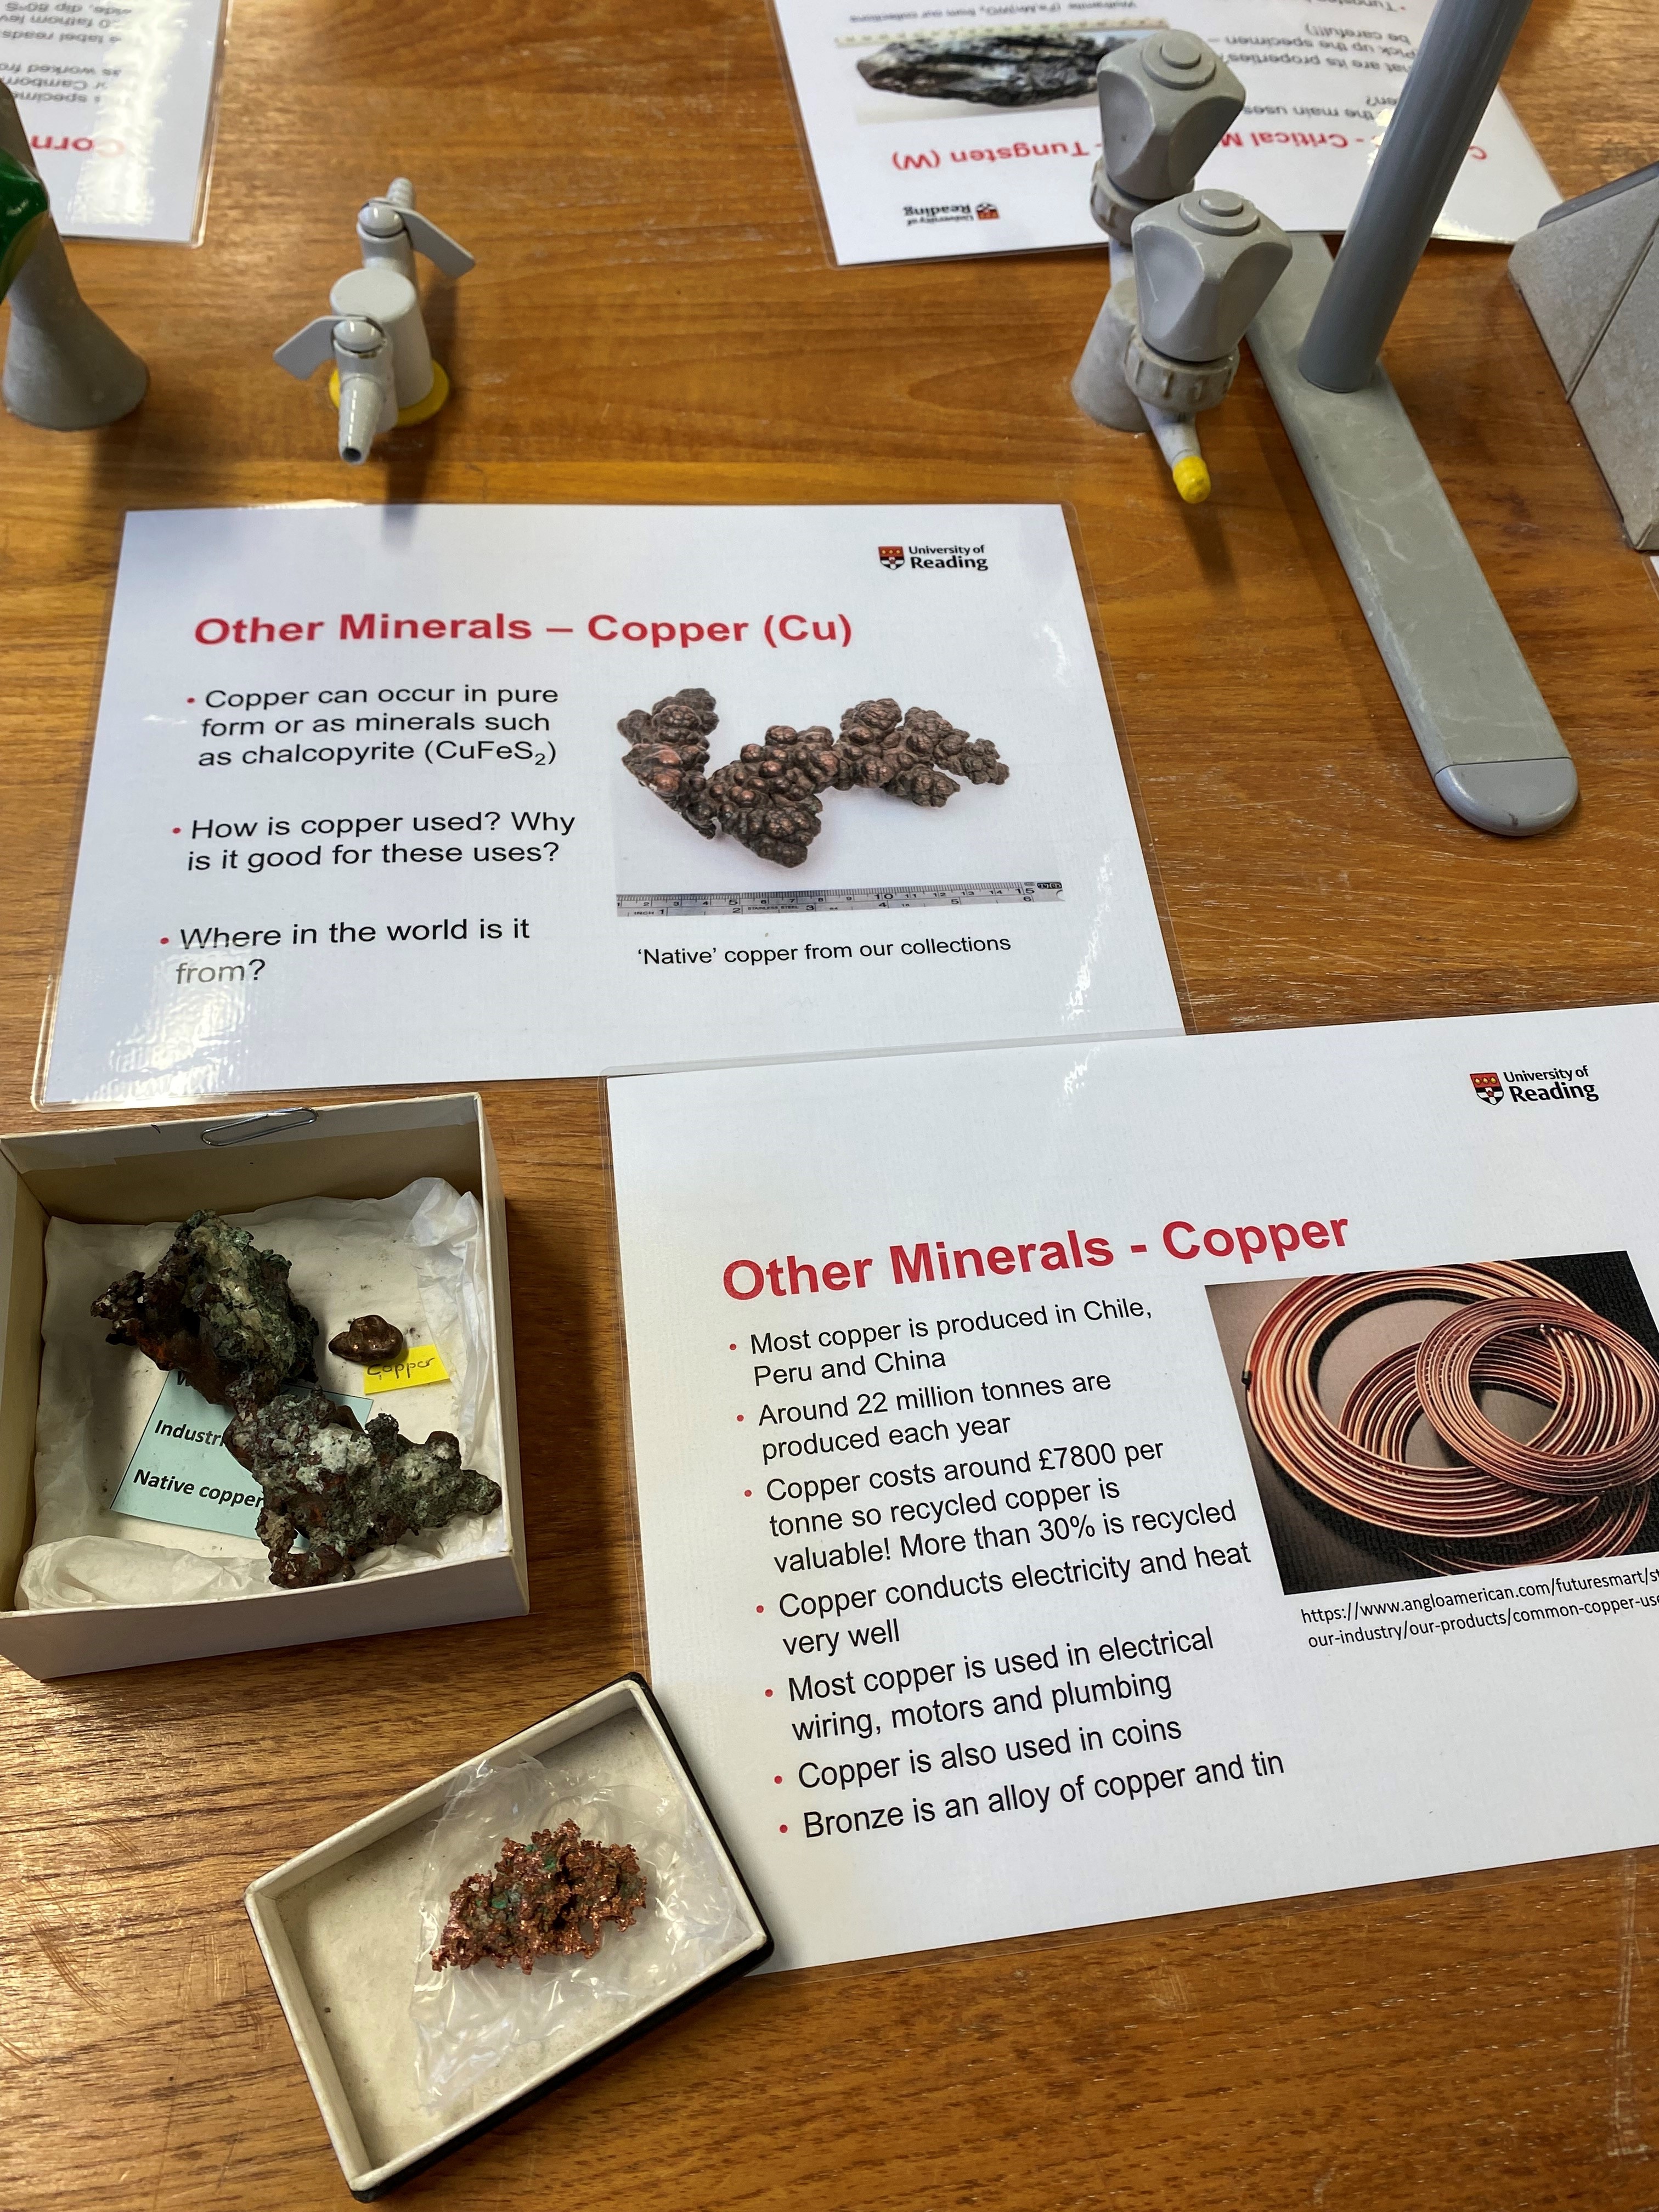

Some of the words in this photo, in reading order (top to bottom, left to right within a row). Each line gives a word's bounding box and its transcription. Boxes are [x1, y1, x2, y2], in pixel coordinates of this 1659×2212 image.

[59, 34, 104, 44] label
[1224, 35, 1314, 49] specimen
[1319, 40, 1347, 52] the
[26, 64, 95, 75] worked
[1352, 59, 1380, 70] are
[1293, 105, 1339, 119] main
[950, 142, 1089, 163] Tungsten
[1250, 131, 1349, 149] Critical
[891, 149, 942, 172] (W)
[902, 204, 972, 217] Reading
[909, 545, 970, 556] University
[973, 545, 985, 554] of
[911, 555, 989, 571] Reading
[194, 616, 325, 645] Other
[339, 612, 532, 640] Minerals
[588, 614, 749, 648] Copper
[763, 613, 852, 648] (Cu)
[205, 690, 310, 712] Copper
[318, 689, 368, 704] can
[377, 688, 456, 703] occur
[465, 684, 487, 702] in
[498, 689, 558, 707] pure
[201, 718, 264, 737] form
[274, 719, 304, 734] or
[312, 718, 346, 733] as
[356, 712, 476, 732] minerals
[484, 713, 550, 731] such
[198, 751, 232, 767] as
[241, 741, 415, 766] chalcopyrite
[191, 819, 258, 839] How
[268, 816, 290, 836] is
[301, 817, 404, 839] copper
[413, 811, 501, 832] used?
[510, 811, 575, 836] Why
[188, 851, 211, 871] is
[222, 849, 239, 870] it
[247, 845, 321, 873] good
[331, 844, 373, 865] for
[381, 843, 463, 864] these
[473, 842, 560, 862] uses?
[179, 927, 281, 950] Where
[292, 923, 317, 945] in
[329, 921, 376, 944] the
[386, 918, 467, 941] world
[480, 918, 503, 939] is
[514, 918, 531, 939] it
[724, 948, 798, 966] copper
[804, 944, 853, 960] from
[859, 944, 894, 957] our
[901, 936, 1012, 955] collections
[176, 958, 266, 984] from?
[1504, 1068, 1572, 1083] University
[1575, 1065, 1589, 1078] of
[1509, 1082, 1600, 1103] Reading
[723, 1255, 873, 1301] Other
[889, 1229, 1114, 1285] Minerals
[1163, 1218, 1348, 1265] Copper
[751, 1329, 811, 1355] Most
[818, 1324, 901, 1350] copper
[908, 1318, 929, 1338] is
[936, 1305, 1048, 1340] produced
[1054, 1304, 1077, 1324] in
[1084, 1298, 1152, 1321] Chile,
[754, 1365, 812, 1387] Peru
[821, 1355, 866, 1379] and
[874, 1350, 946, 1373] China
[758, 1395, 849, 1426] Around
[856, 1392, 888, 1415] 22
[896, 1385, 974, 1411] million
[980, 1379, 1065, 1402] tonnes
[1072, 1374, 1111, 1393] are
[762, 1425, 880, 1466] produced
[889, 1419, 950, 1445] each
[956, 1417, 1011, 1444] year
[766, 1475, 861, 1503] Copper
[869, 1463, 936, 1489] costs
[944, 1451, 1031, 1481] around
[1038, 1442, 1116, 1471] £7800
[1124, 1442, 1164, 1468] per
[133, 1469, 195, 1495] Native
[199, 1486, 264, 1508] copper
[769, 1513, 843, 1537] tonne
[851, 1508, 882, 1527] so
[890, 1488, 997, 1524] recycled
[1005, 1484, 1091, 1512] copper
[1098, 1477, 1120, 1499] is
[773, 1537, 891, 1573] valuable!
[900, 1533, 967, 1559] More
[973, 1526, 1031, 1550] than
[1037, 1514, 1096, 1542] 30%
[1102, 1513, 1125, 1535] is
[1131, 1499, 1237, 1533] recycled
[779, 1589, 877, 1620] Copper
[885, 1571, 1003, 1605] conducts
[1011, 1556, 1131, 1589] electricity
[1139, 1547, 1187, 1575] and
[1193, 1541, 1252, 1568] heat
[1308, 1595, 1659, 1649] our-industry/our-products/common-copper-us
[782, 1631, 840, 1657] very
[847, 1618, 900, 1647] well
[788, 1671, 856, 1702] Most
[864, 1663, 956, 1695] copper
[963, 1655, 986, 1679] is
[994, 1644, 1059, 1675] used
[1066, 1643, 1091, 1667] in
[1098, 1626, 1214, 1662] electrical
[791, 1711, 881, 1741] wiring,
[891, 1699, 984, 1729] motors
[992, 1685, 1043, 1715] and
[1051, 1673, 1172, 1714] plumbing
[798, 1757, 901, 1790] Copper
[909, 1749, 932, 1774] is
[940, 1742, 997, 1770] also
[1005, 1728, 1071, 1761] used
[1079, 1726, 1104, 1751] in
[1112, 1718, 1182, 1747] coins
[803, 1807, 904, 1838] Bronze
[912, 1797, 936, 1824] is
[945, 1796, 979, 1819] an
[988, 1784, 1050, 1813] alloy
[1059, 1774, 1085, 1803] of
[1094, 1768, 1186, 1801] copper
[1194, 1754, 1245, 1785] and
[1251, 1751, 1284, 1777] tin
